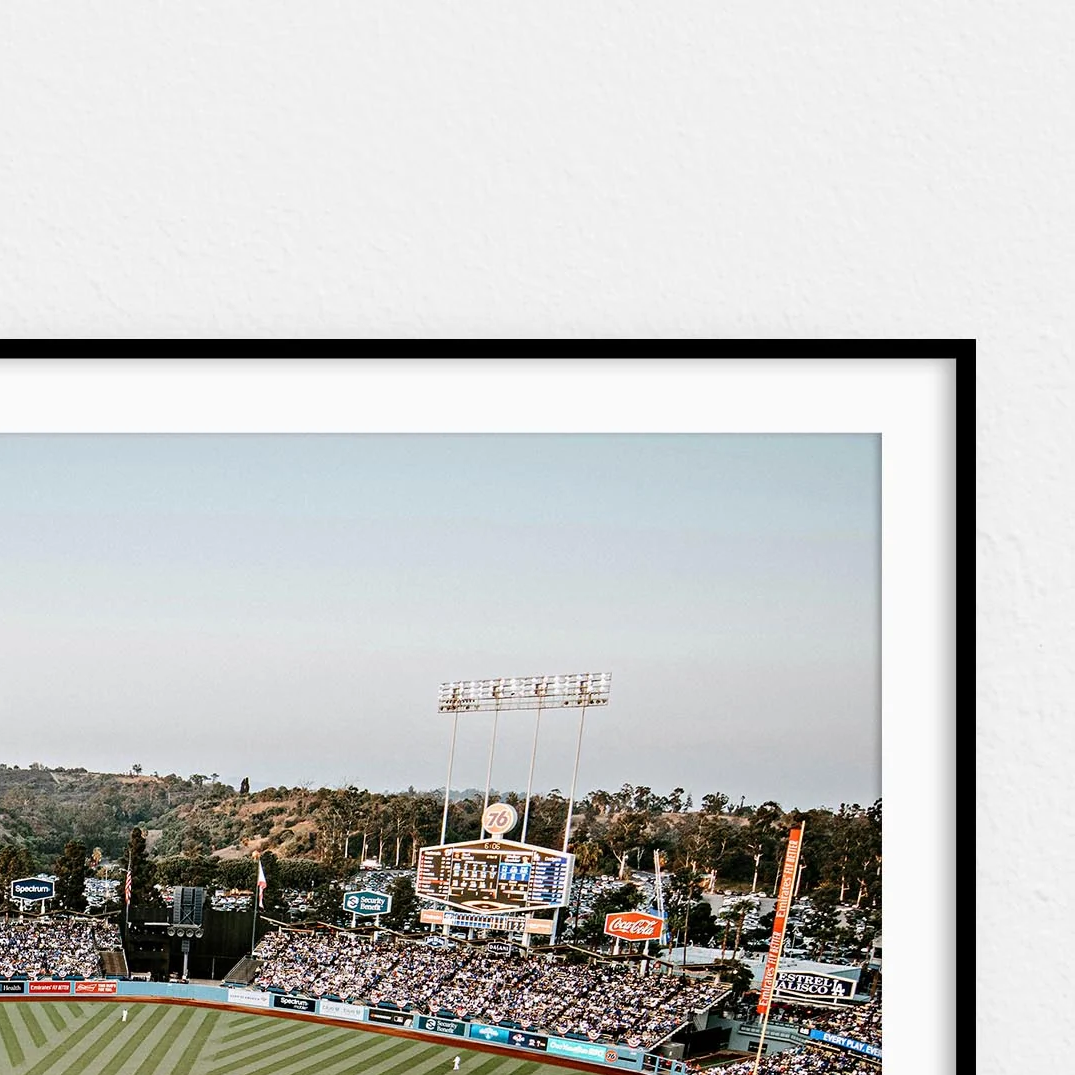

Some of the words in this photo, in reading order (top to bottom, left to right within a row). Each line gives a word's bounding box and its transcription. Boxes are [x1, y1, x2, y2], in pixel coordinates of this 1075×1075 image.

[487, 810, 508, 827] 76
[785, 840, 799, 863] BETTER
[783, 863, 794, 876] FLY
[15, 885, 49, 894] Spectrum
[360, 896, 386, 906] Security
[776, 877, 792, 918] Emirates
[360, 903, 382, 911] Benefit
[609, 917, 658, 936] Coca-Cola
[769, 932, 782, 952] BETTER
[767, 952, 777, 965] FLY
[759, 966, 775, 1007] Emirates
[281, 996, 309, 1006] Spectrum
[436, 1020, 458, 1030] Security
[823, 1032, 847, 1046] EVERY
[847, 1038, 866, 1052] PLAY.
